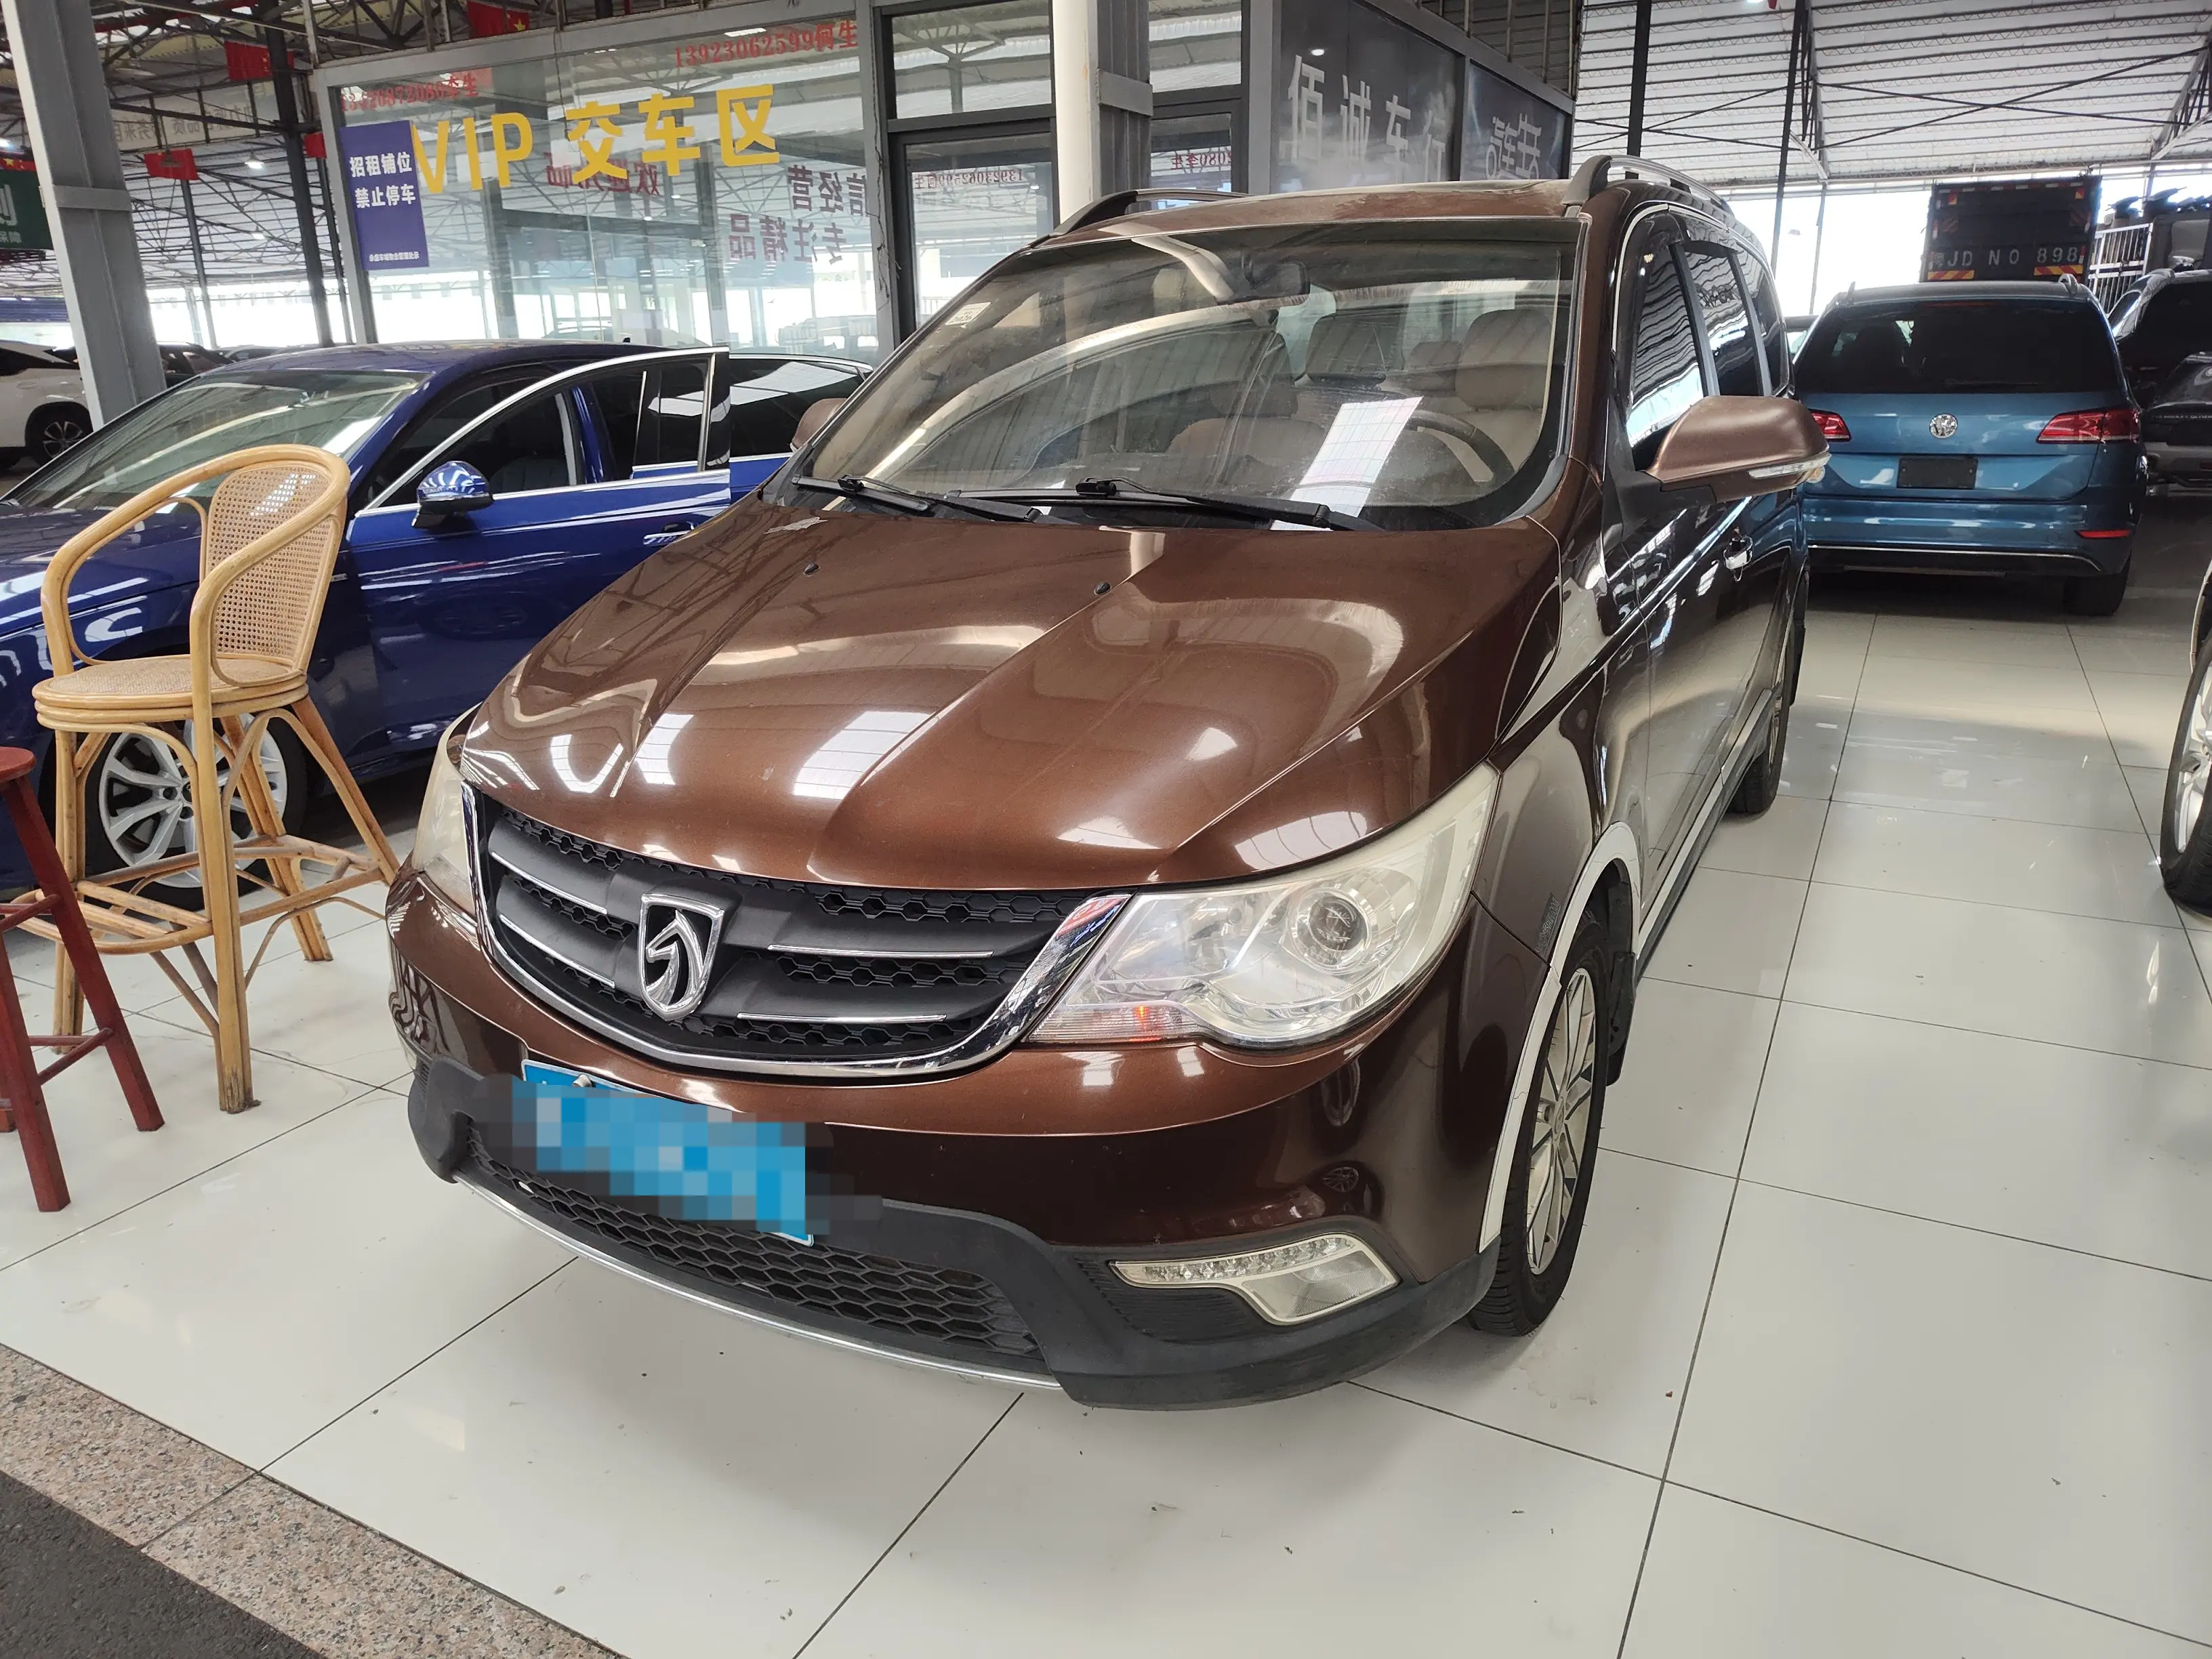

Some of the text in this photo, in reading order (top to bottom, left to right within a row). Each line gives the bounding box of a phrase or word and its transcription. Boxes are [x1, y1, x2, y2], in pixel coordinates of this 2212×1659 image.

[411, 83, 781, 194] VIP 交车区
[349, 151, 413, 178] 招租铺位
[354, 183, 416, 209] 禁止停车
